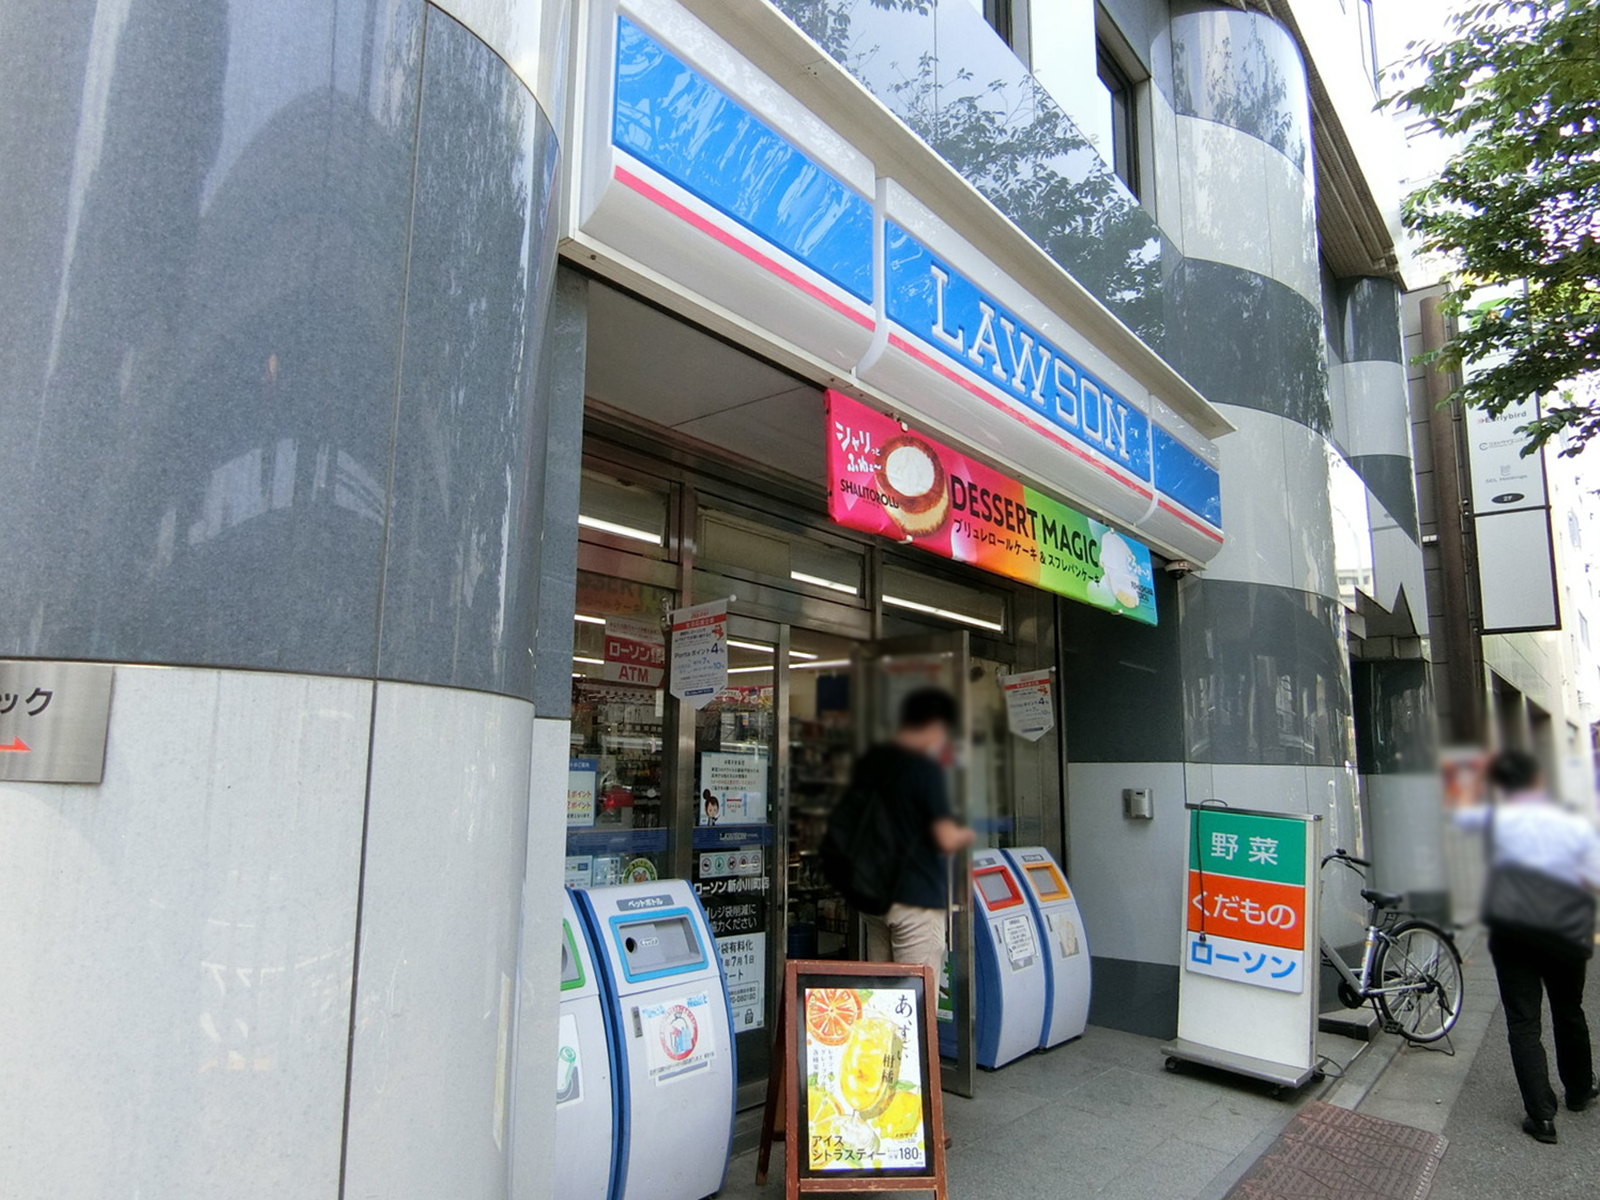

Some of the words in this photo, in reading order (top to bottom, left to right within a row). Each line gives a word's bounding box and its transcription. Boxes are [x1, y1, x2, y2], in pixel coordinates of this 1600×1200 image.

[930, 264, 1130, 461] LAWSON
[951, 474, 1038, 540] DESSERT
[1041, 514, 1099, 568] MAGIC
[954, 518, 1038, 562] ブリュレロールケーキ
[1049, 554, 1100, 588] スフレパンケーキ
[619, 665, 649, 682] ATM
[1211, 832, 1279, 865] 野菜
[1191, 890, 1296, 929] くだもの
[1191, 941, 1296, 979] ローソン
[812, 1135, 845, 1147] アイス
[812, 1148, 886, 1161] シトラスティー
